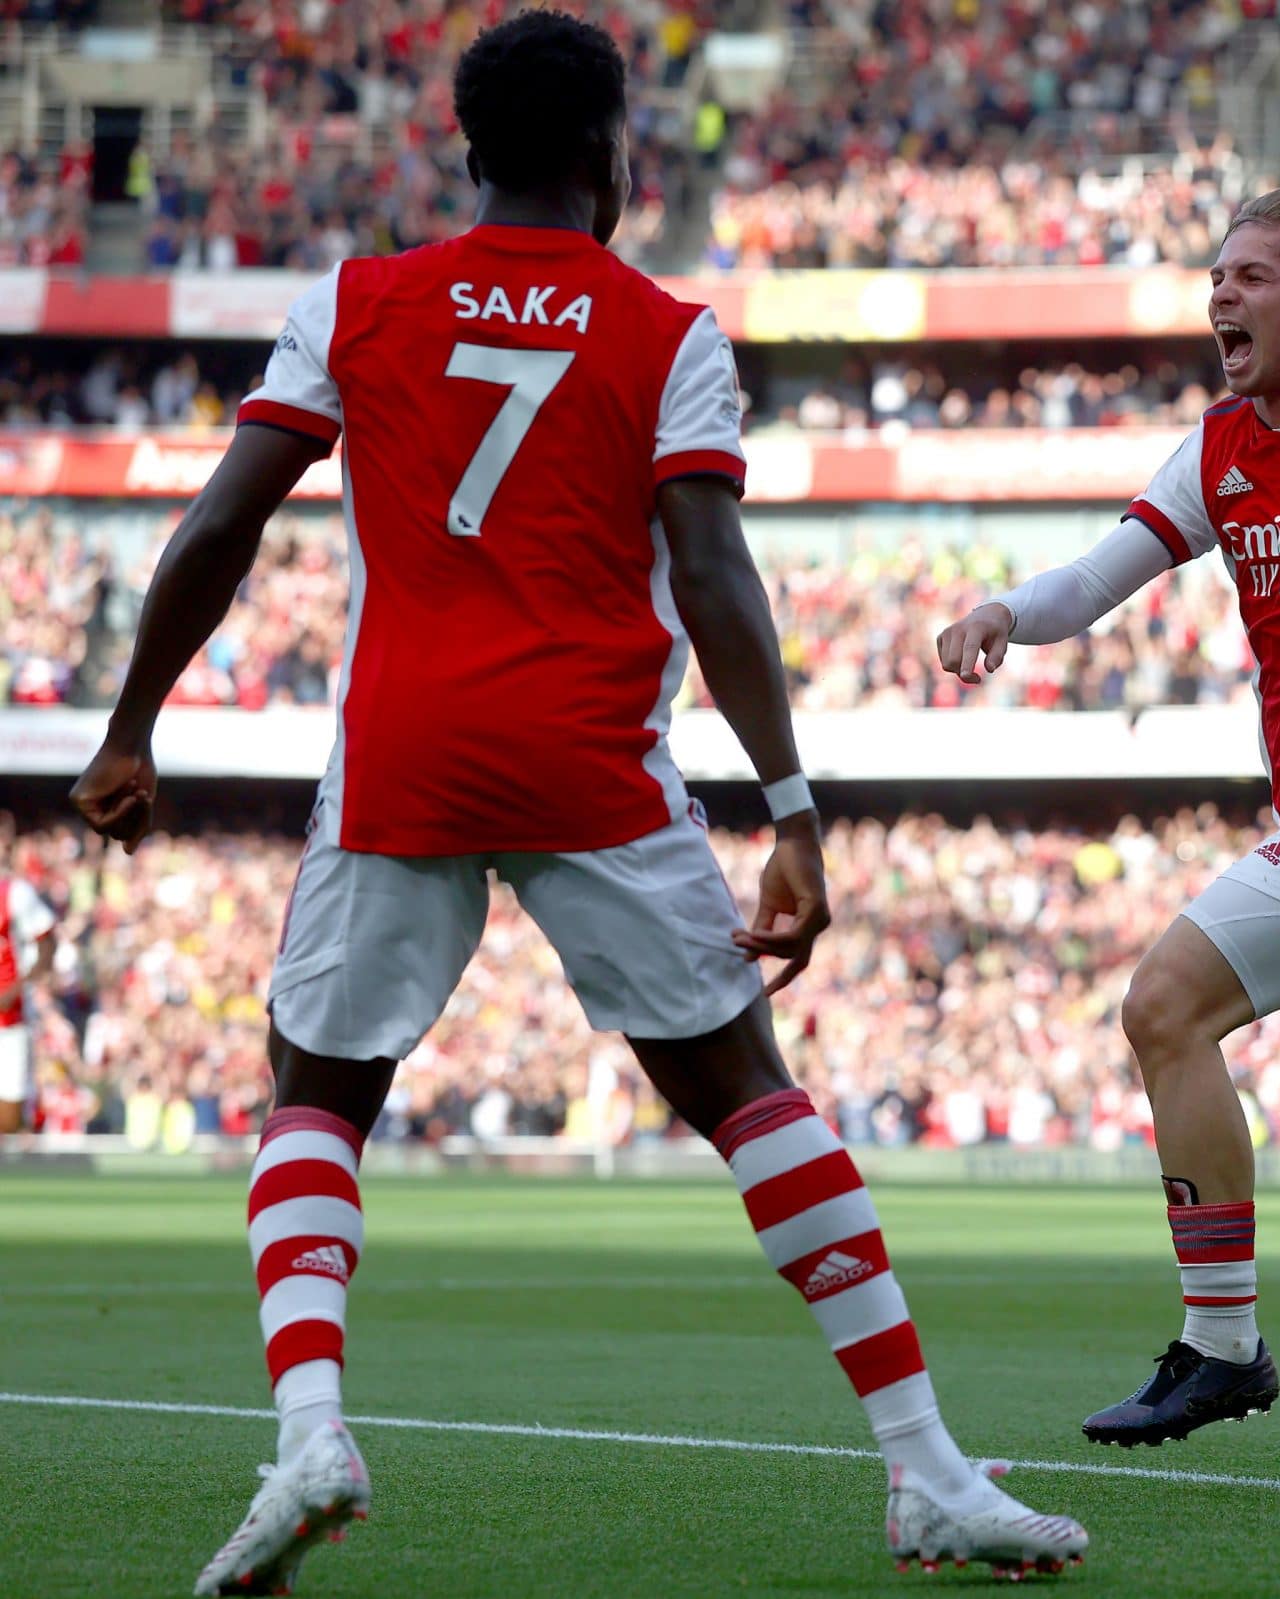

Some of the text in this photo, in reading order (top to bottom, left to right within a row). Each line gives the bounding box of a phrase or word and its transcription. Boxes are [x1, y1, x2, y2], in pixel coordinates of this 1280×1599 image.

[449, 281, 593, 335] SAKA
[444, 341, 576, 537] 7
[1216, 481, 1254, 497] adidas
[1249, 563, 1279, 597] FLY
[803, 1260, 874, 1295] adidas
